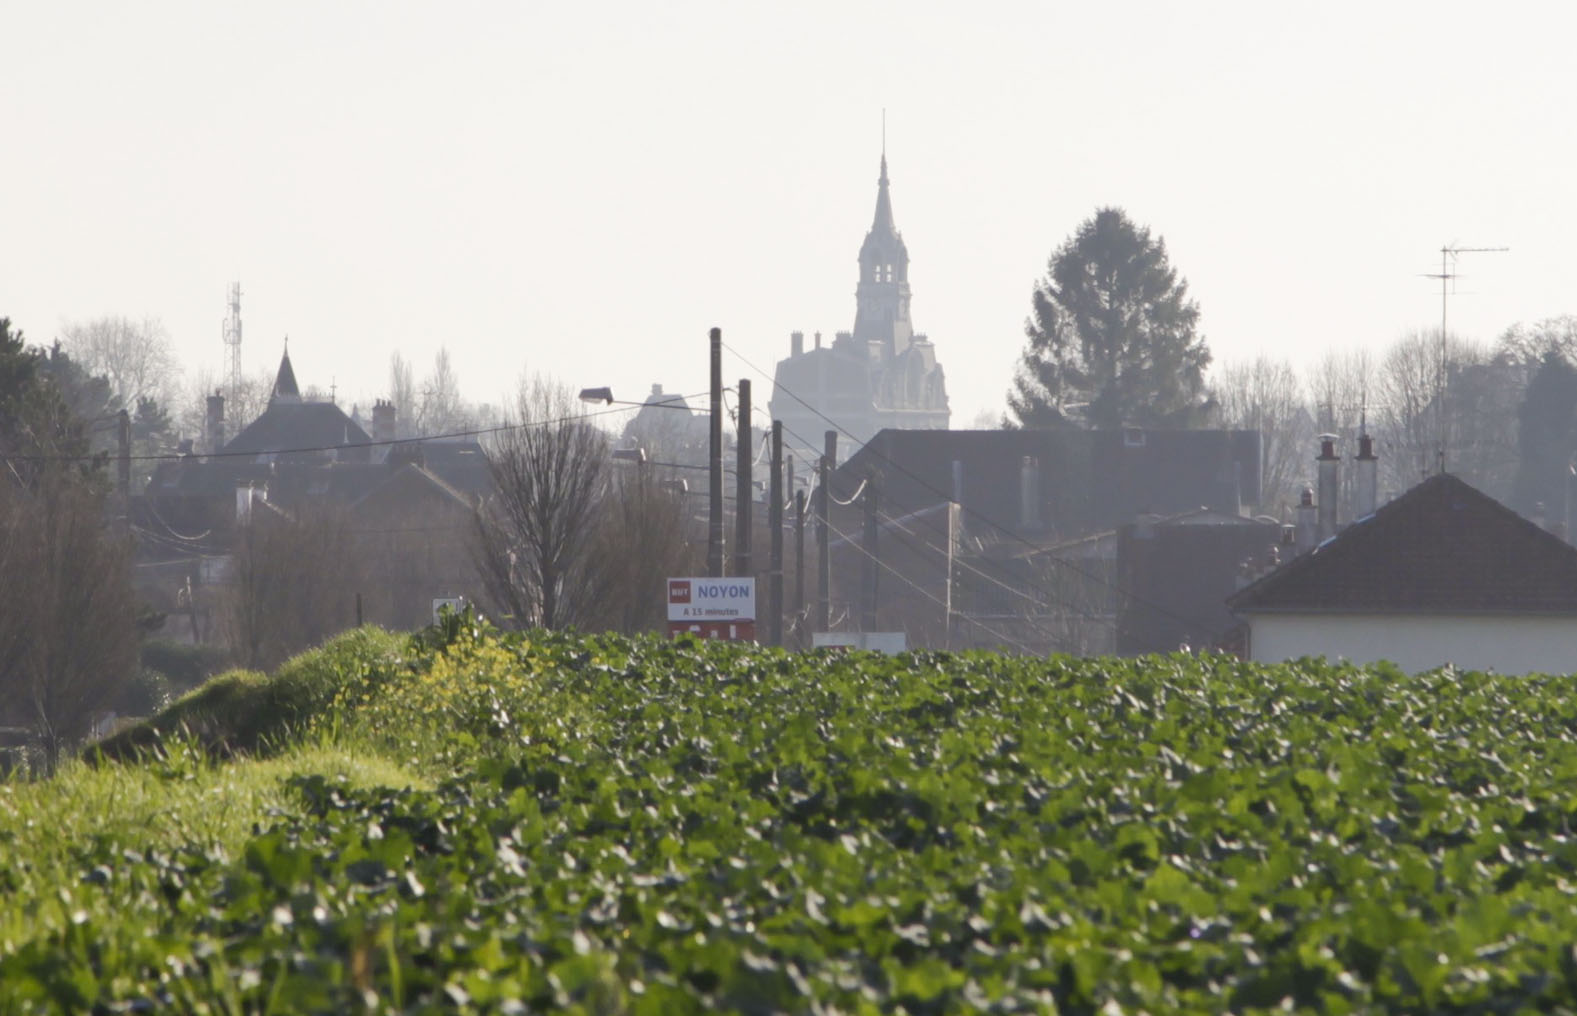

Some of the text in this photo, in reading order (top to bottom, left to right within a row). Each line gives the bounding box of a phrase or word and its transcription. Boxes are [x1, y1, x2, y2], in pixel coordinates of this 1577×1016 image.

[698, 585, 749, 598] NOYON
[693, 608, 703, 616] 15
[705, 608, 739, 616] minutes
